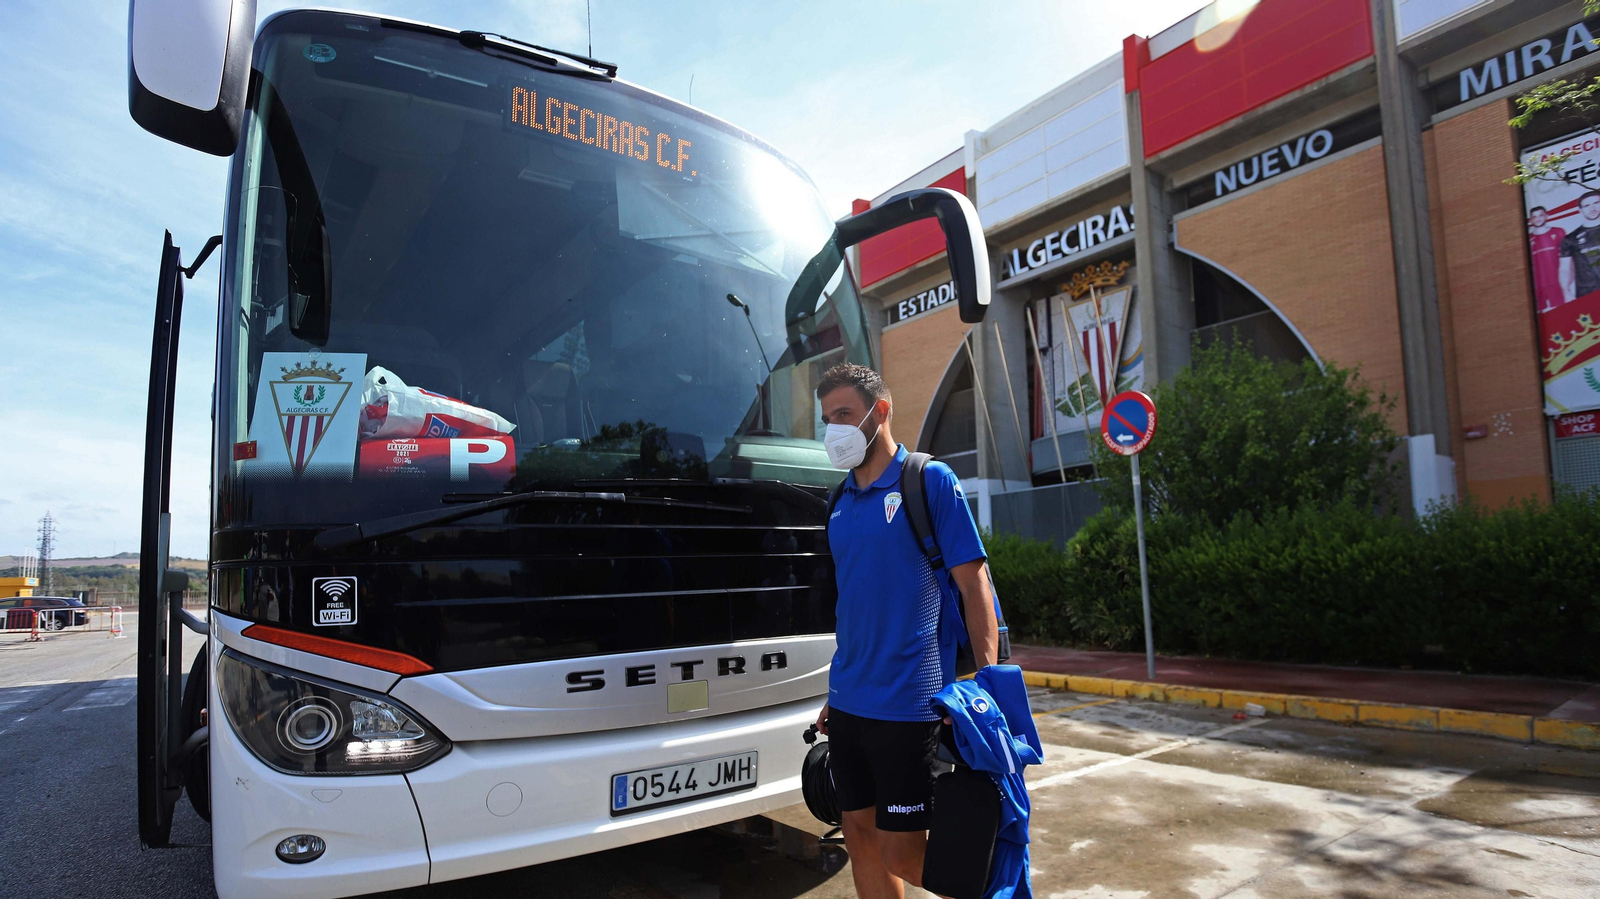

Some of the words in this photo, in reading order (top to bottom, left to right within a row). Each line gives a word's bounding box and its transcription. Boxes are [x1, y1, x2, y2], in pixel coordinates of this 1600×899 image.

[1459, 21, 1600, 102] MIRA
[511, 86, 650, 161] ALGECIRAS
[656, 132, 697, 176] C.F.
[1215, 129, 1334, 197] NUEVO
[898, 280, 958, 321] ESTADI
[1560, 414, 1596, 426] SHOP
[1571, 422, 1596, 434] ACF
[449, 438, 507, 482] P
[322, 611, 350, 621] Wi-Fi
[566, 650, 788, 693] SETRA
[618, 795, 624, 803] E
[633, 767, 698, 801] 0544
[708, 757, 751, 787] JMH
[887, 803, 924, 815] uhlsport
